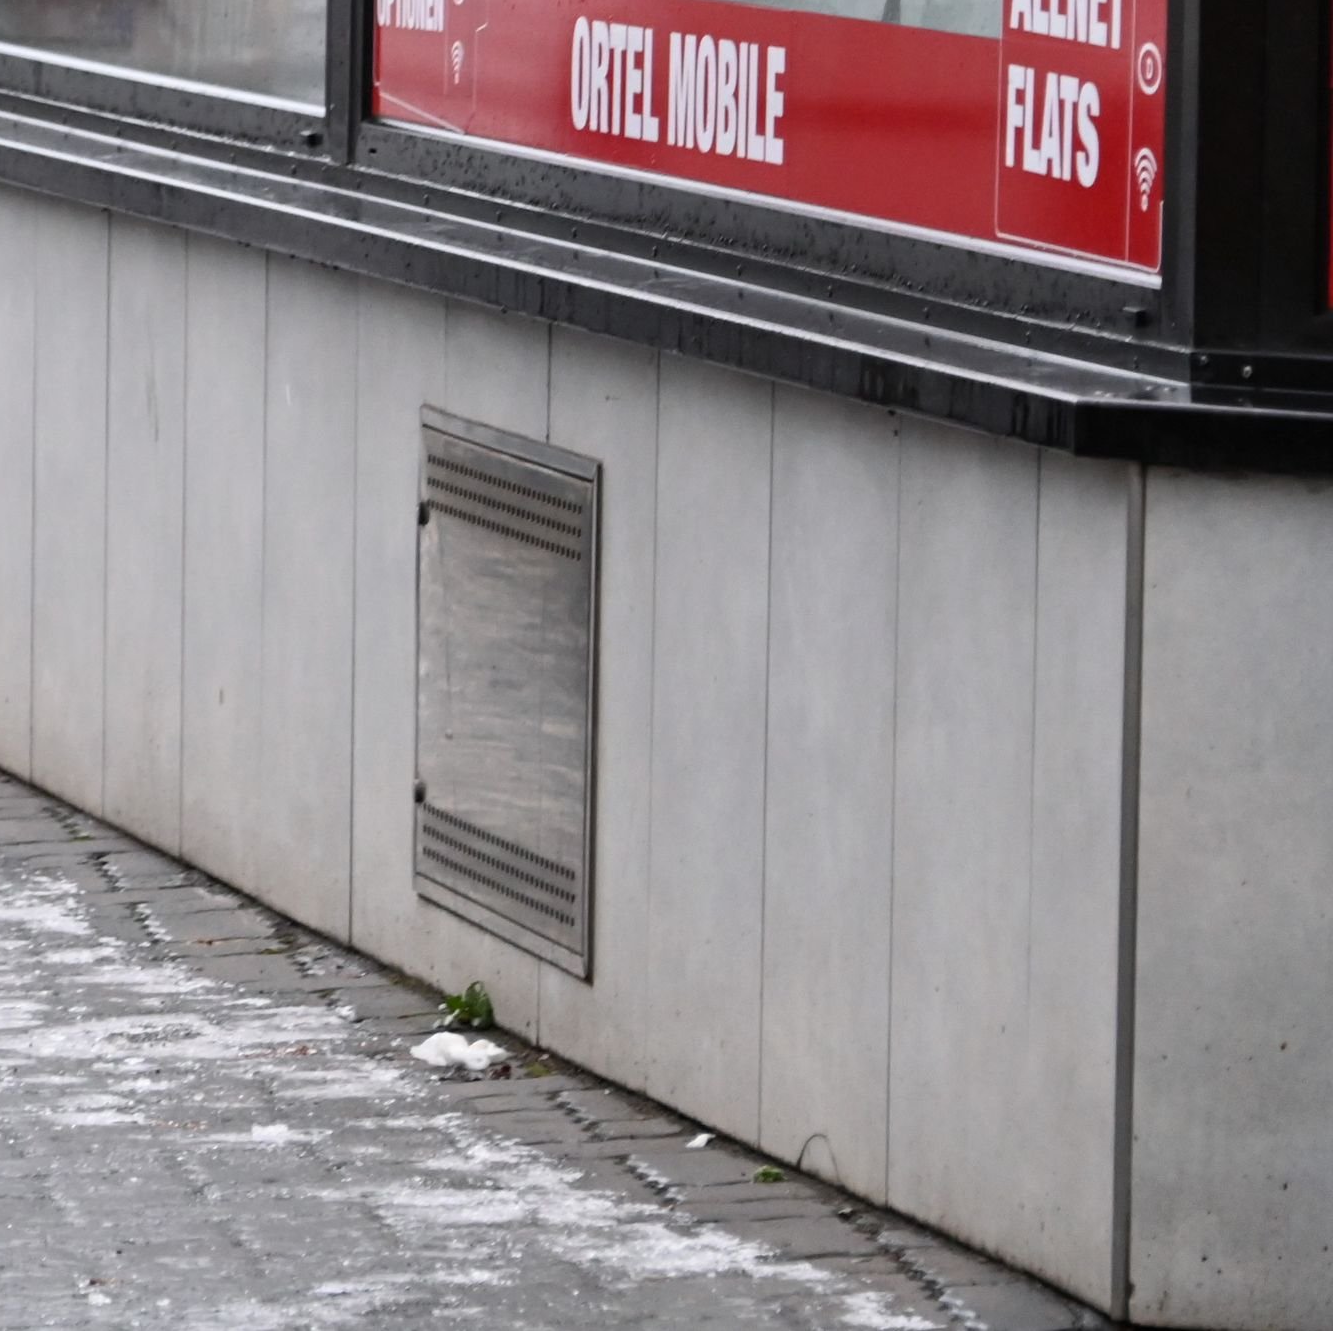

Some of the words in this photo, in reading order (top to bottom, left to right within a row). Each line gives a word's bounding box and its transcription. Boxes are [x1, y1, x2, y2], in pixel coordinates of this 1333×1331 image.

[570, 15, 660, 142] ORTEL
[666, 31, 787, 165] MOBILE
[1005, 63, 1101, 188] FLATS
